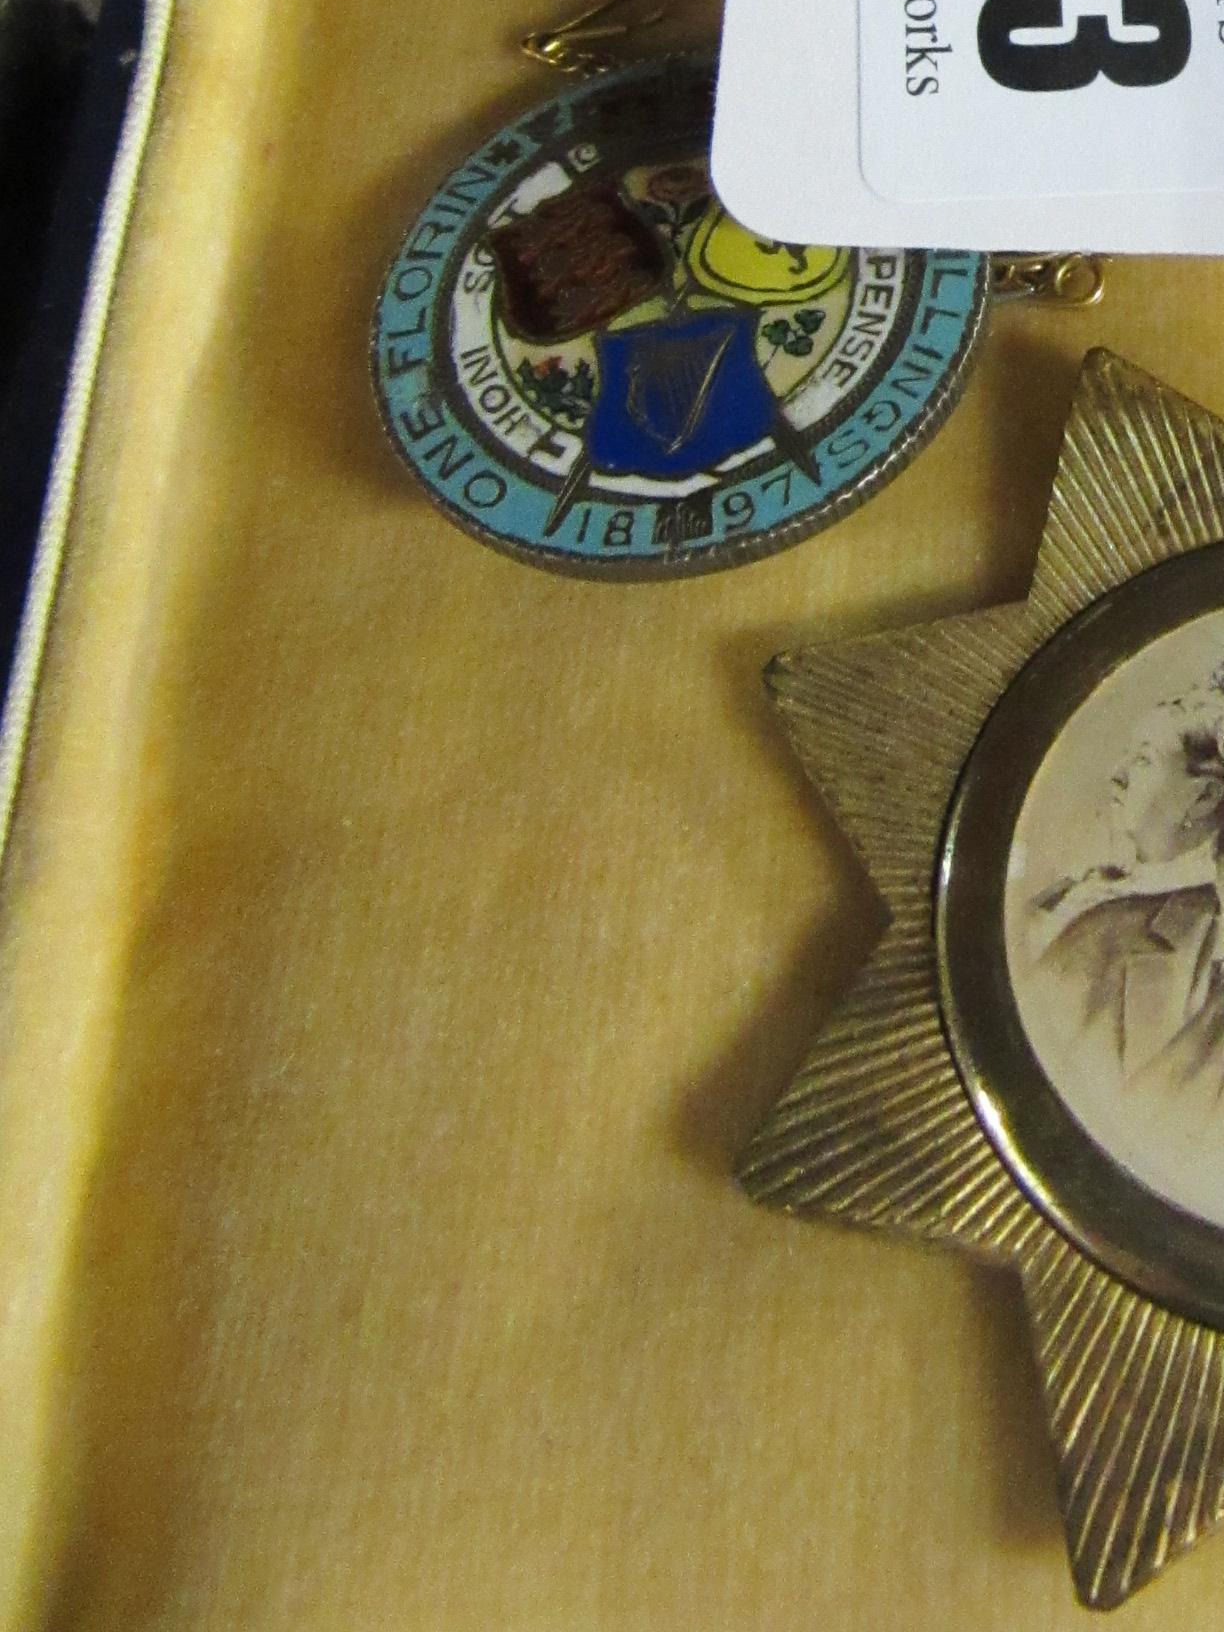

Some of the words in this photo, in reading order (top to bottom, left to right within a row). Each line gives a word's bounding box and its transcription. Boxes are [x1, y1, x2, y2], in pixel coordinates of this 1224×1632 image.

[386, 164, 499, 379] FLORIN
[822, 254, 898, 389] PENSE
[459, 345, 536, 436] HONI
[826, 248, 973, 470] ILLINGS
[400, 398, 508, 509] ONE
